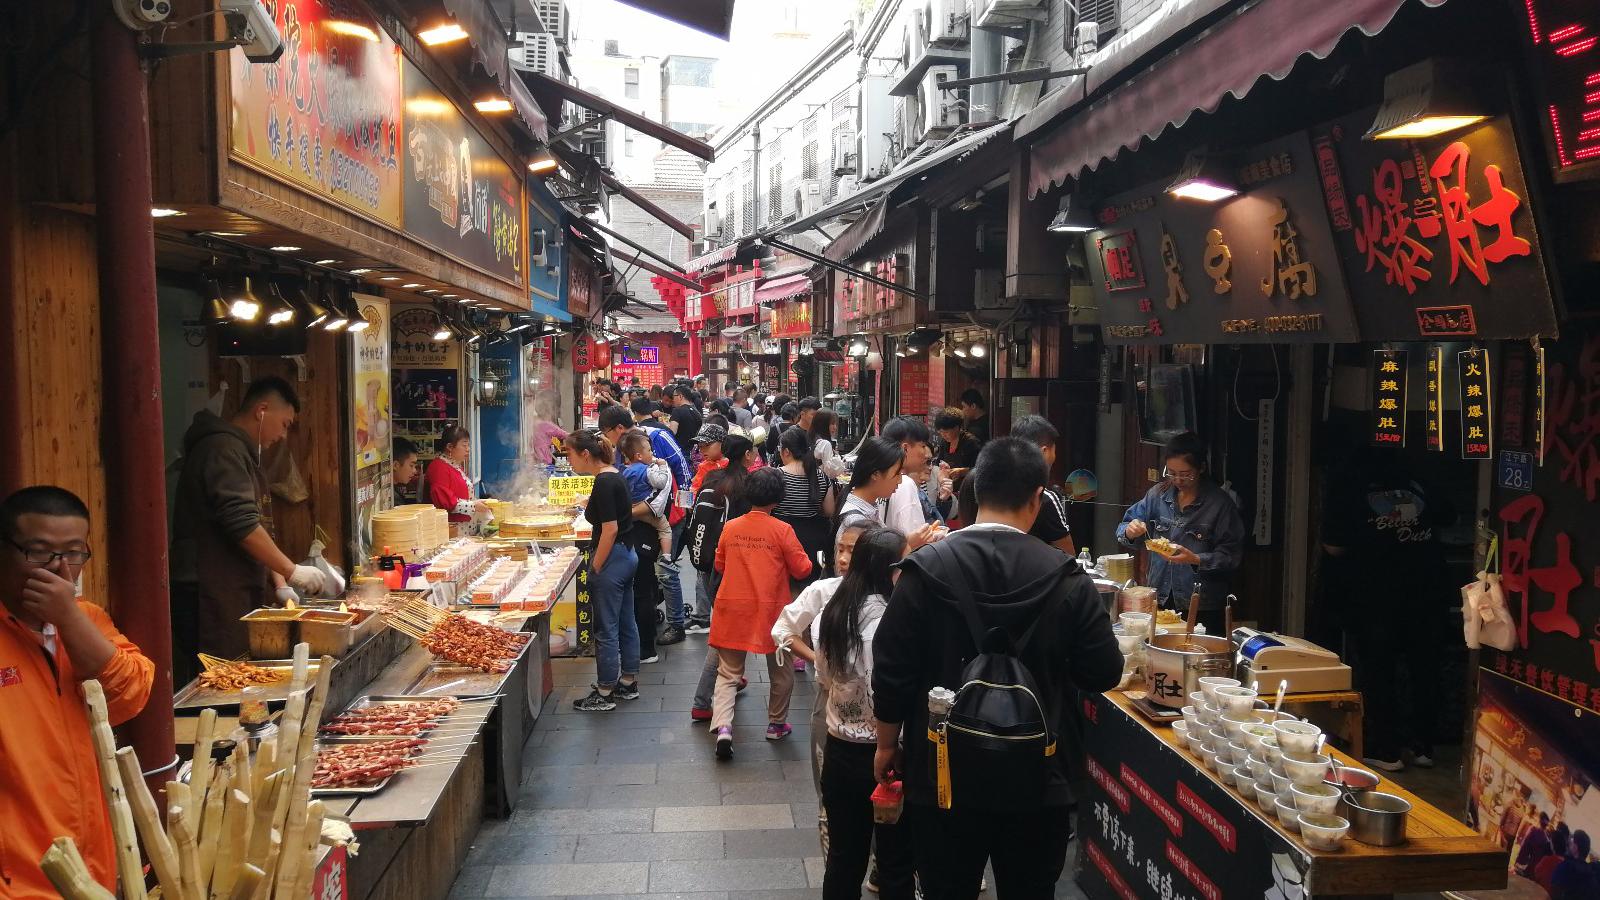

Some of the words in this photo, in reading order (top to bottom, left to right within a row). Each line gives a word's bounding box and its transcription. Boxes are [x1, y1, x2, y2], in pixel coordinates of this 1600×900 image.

[1160, 197, 1318, 310] 臭豆腐
[1354, 141, 1531, 296] 爆肚
[1377, 360, 1400, 429] 麻辣爆肚
[1466, 363, 1484, 440] 火辣爆肚
[692, 523, 706, 565] adidas
[1153, 672, 1183, 699] 肚
